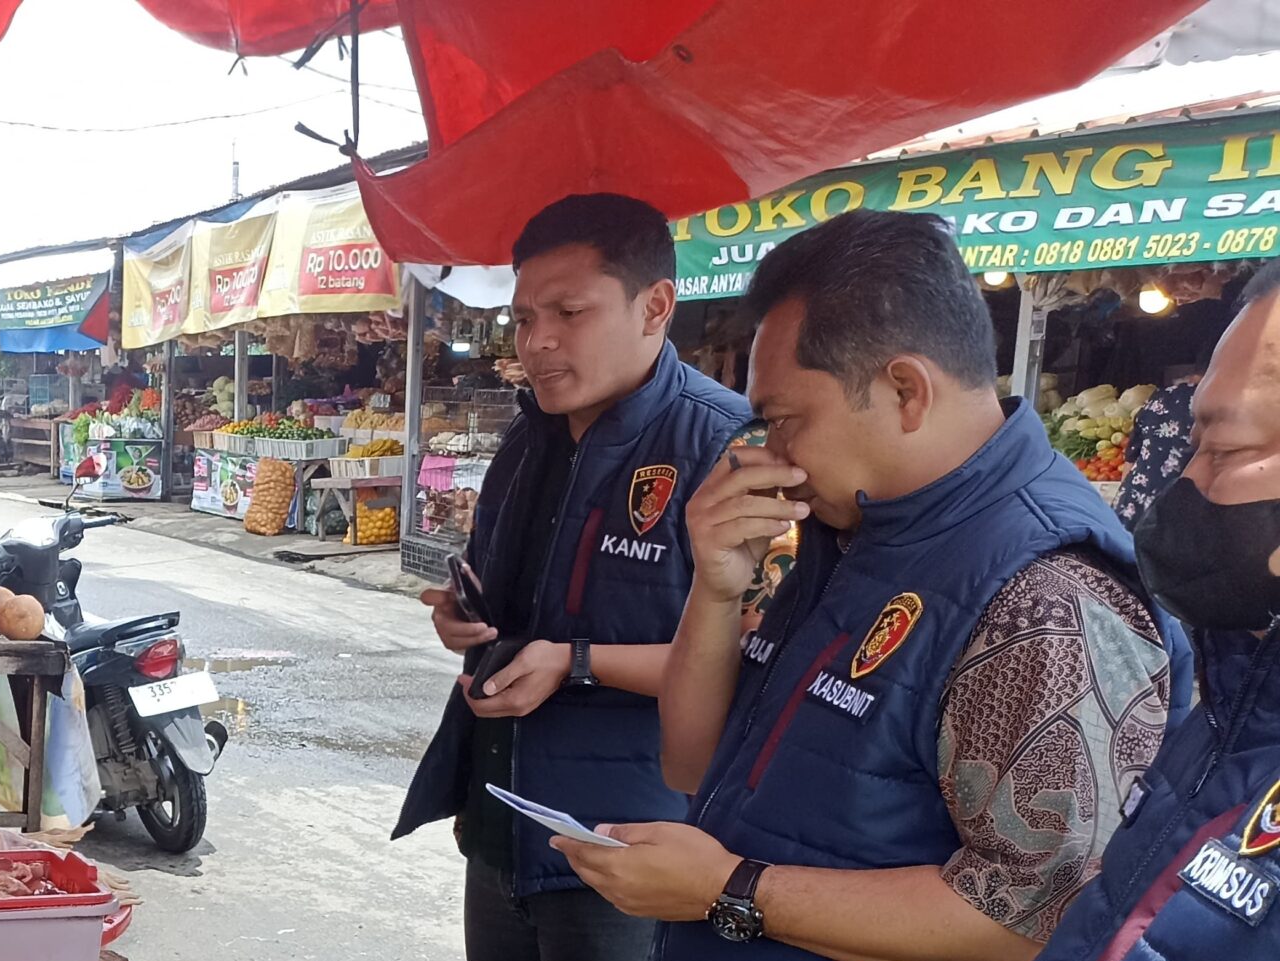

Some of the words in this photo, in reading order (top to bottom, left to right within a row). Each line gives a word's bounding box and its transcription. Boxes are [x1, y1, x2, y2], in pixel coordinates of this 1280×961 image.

[888, 142, 1173, 211] BANG
[1053, 198, 1187, 229] DAN
[1033, 239, 1085, 266] 0818
[1087, 236, 1140, 263] 0881
[1143, 231, 1201, 259] 5023
[1217, 226, 1279, 254] 0878
[306, 252, 325, 276] Rp
[328, 247, 381, 271] 10.000
[215, 274, 231, 296] Rp
[318, 276, 327, 288] 12
[328, 276, 365, 290] batang
[16, 298, 54, 311] SEMBAKO
[600, 534, 667, 562] KANIT
[806, 670, 875, 718] KASUBNIT
